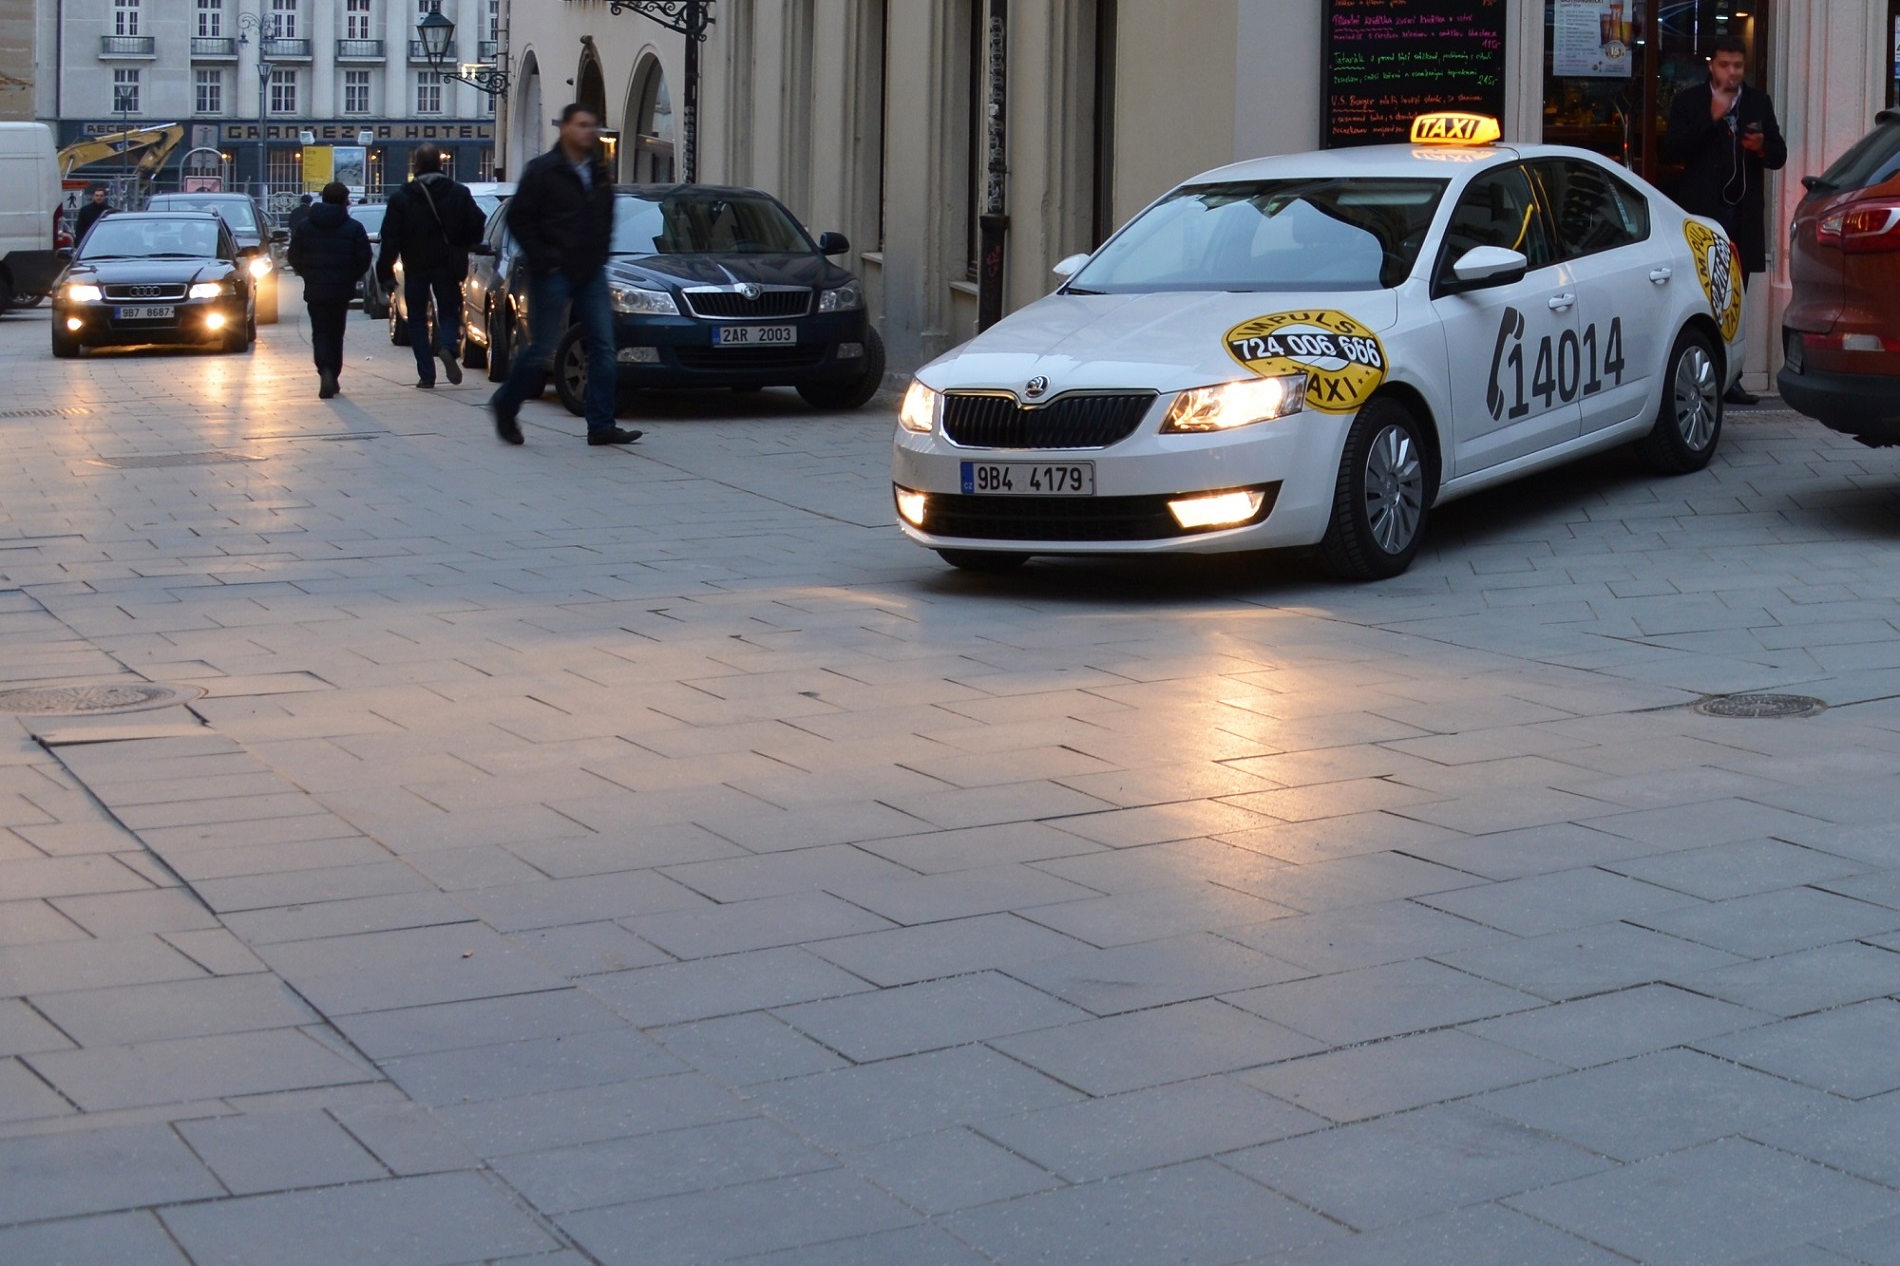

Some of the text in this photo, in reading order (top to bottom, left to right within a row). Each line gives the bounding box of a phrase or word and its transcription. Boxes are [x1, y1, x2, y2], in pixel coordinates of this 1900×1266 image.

[406, 126, 490, 138] HOTEL
[1420, 118, 1476, 138] TAXI
[122, 308, 140, 317] 9B7
[724, 328, 790, 342] 2AR 2003
[1236, 312, 1358, 336] IMPULS
[1233, 334, 1381, 368] 724 006 666
[1508, 316, 1625, 420] 14014
[1292, 365, 1358, 402] TAXI
[964, 482, 973, 490] CZ
[978, 466, 1082, 491] 9B4 4179
